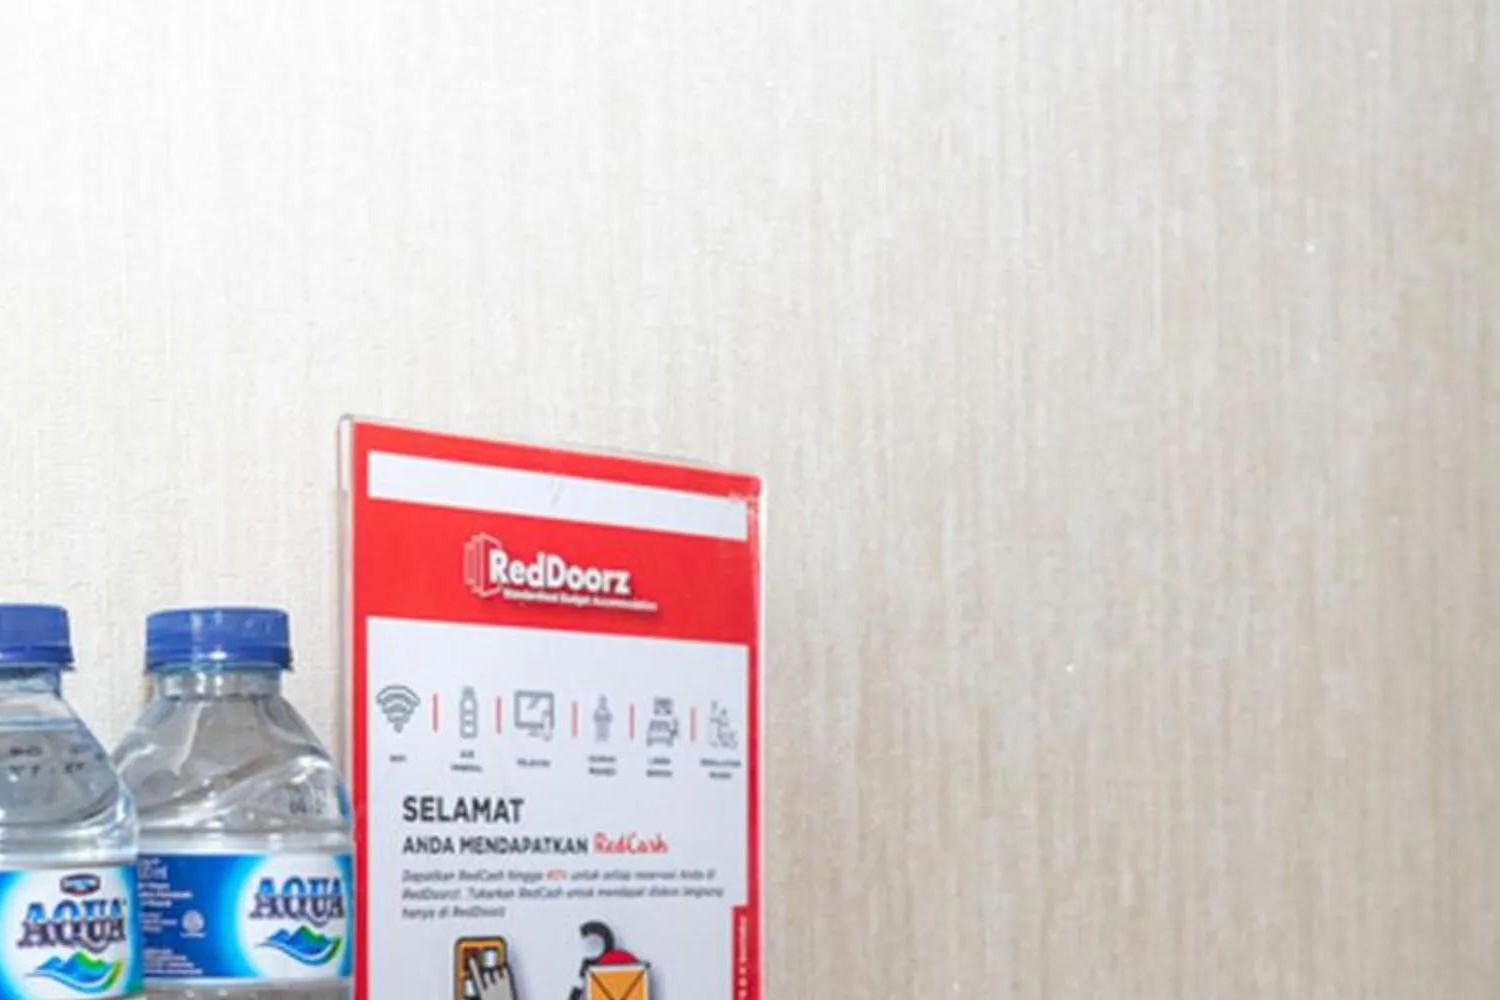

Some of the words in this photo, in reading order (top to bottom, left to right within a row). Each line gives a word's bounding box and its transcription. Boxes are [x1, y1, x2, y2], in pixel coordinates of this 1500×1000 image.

[488, 548, 632, 595] RedDoorz
[402, 795, 525, 824] SELAMAT
[402, 835, 455, 855] ANDA
[458, 834, 589, 855] MENDAPATKAN
[593, 831, 669, 855] RedCash
[248, 875, 346, 928] AQUA
[17, 898, 127, 953] AQUA
